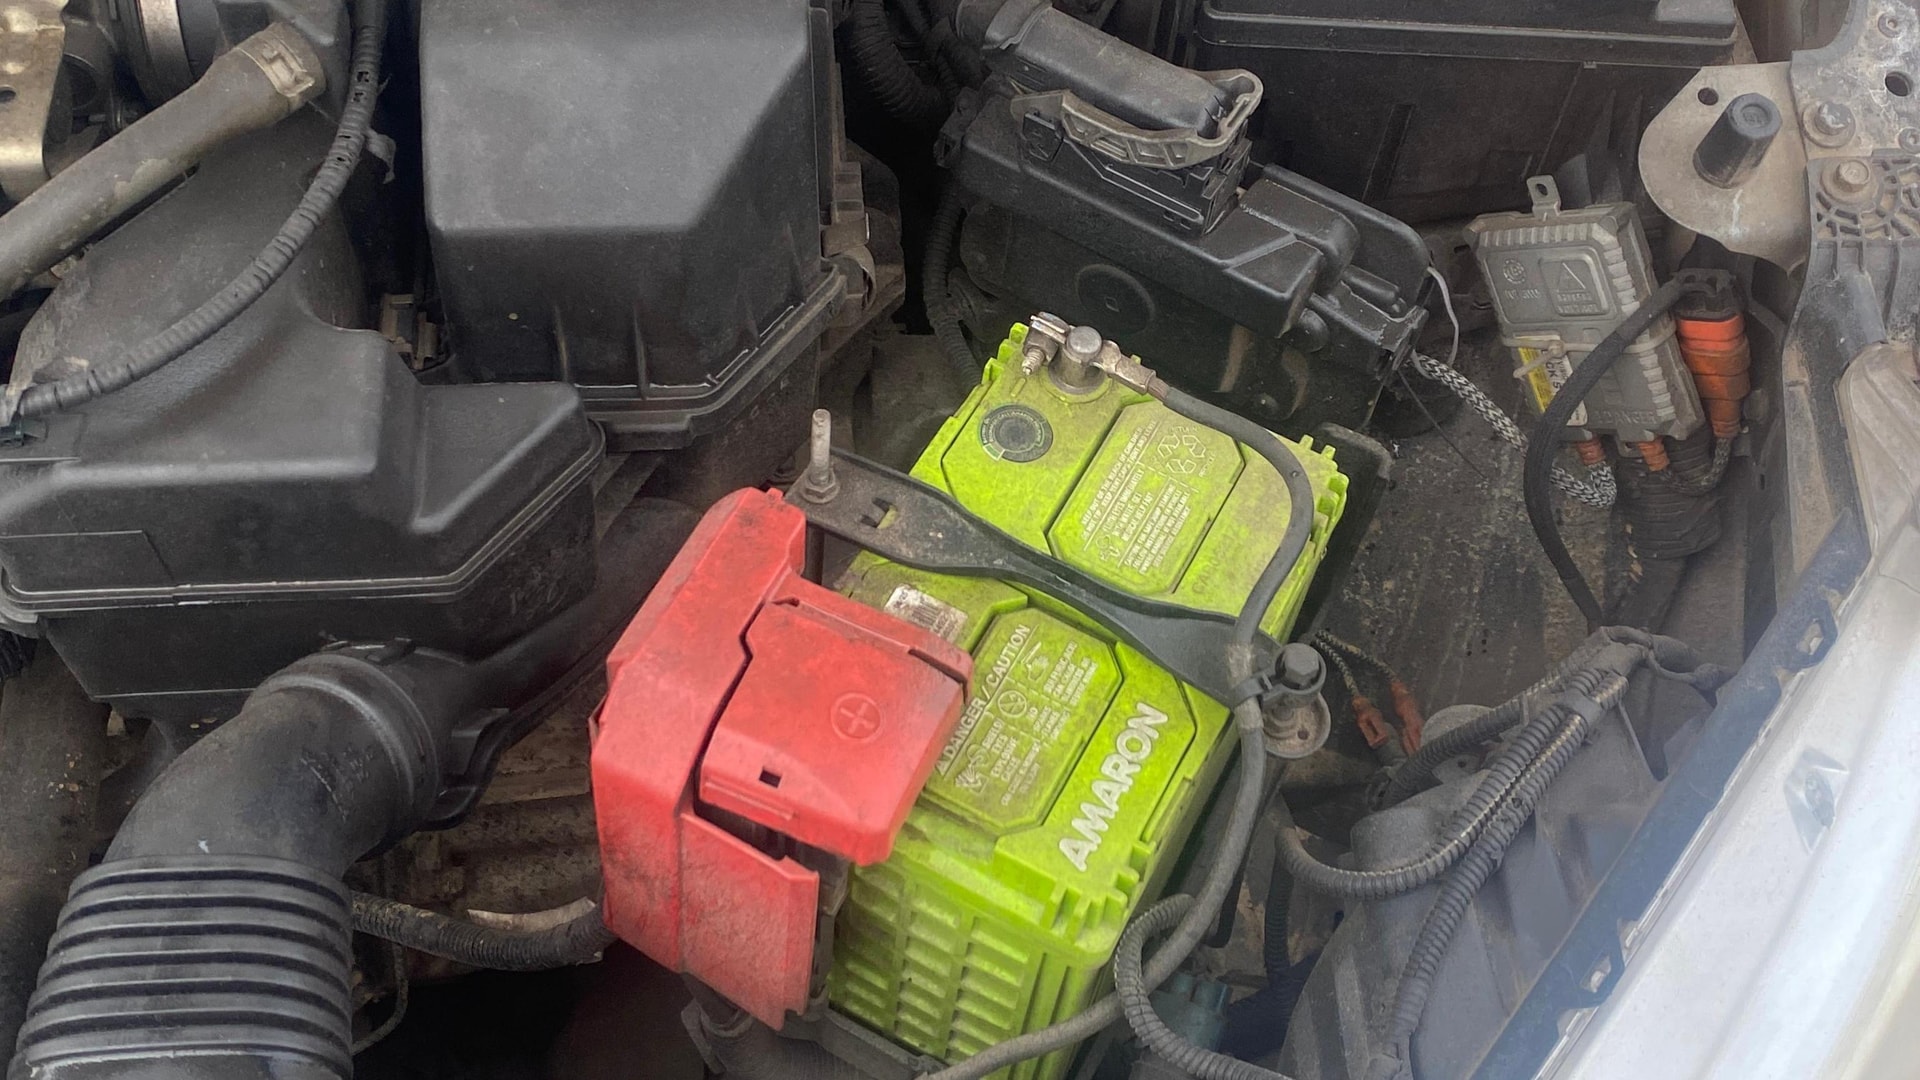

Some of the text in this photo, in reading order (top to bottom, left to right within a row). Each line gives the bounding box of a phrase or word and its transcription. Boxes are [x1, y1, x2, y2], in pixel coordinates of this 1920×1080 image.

[944, 698, 985, 758] DANGER
[986, 624, 1031, 688] CAUTION
[980, 719, 1004, 749] SHIELD
[990, 732, 1009, 754] EYES
[1058, 701, 1169, 872] AMARON
